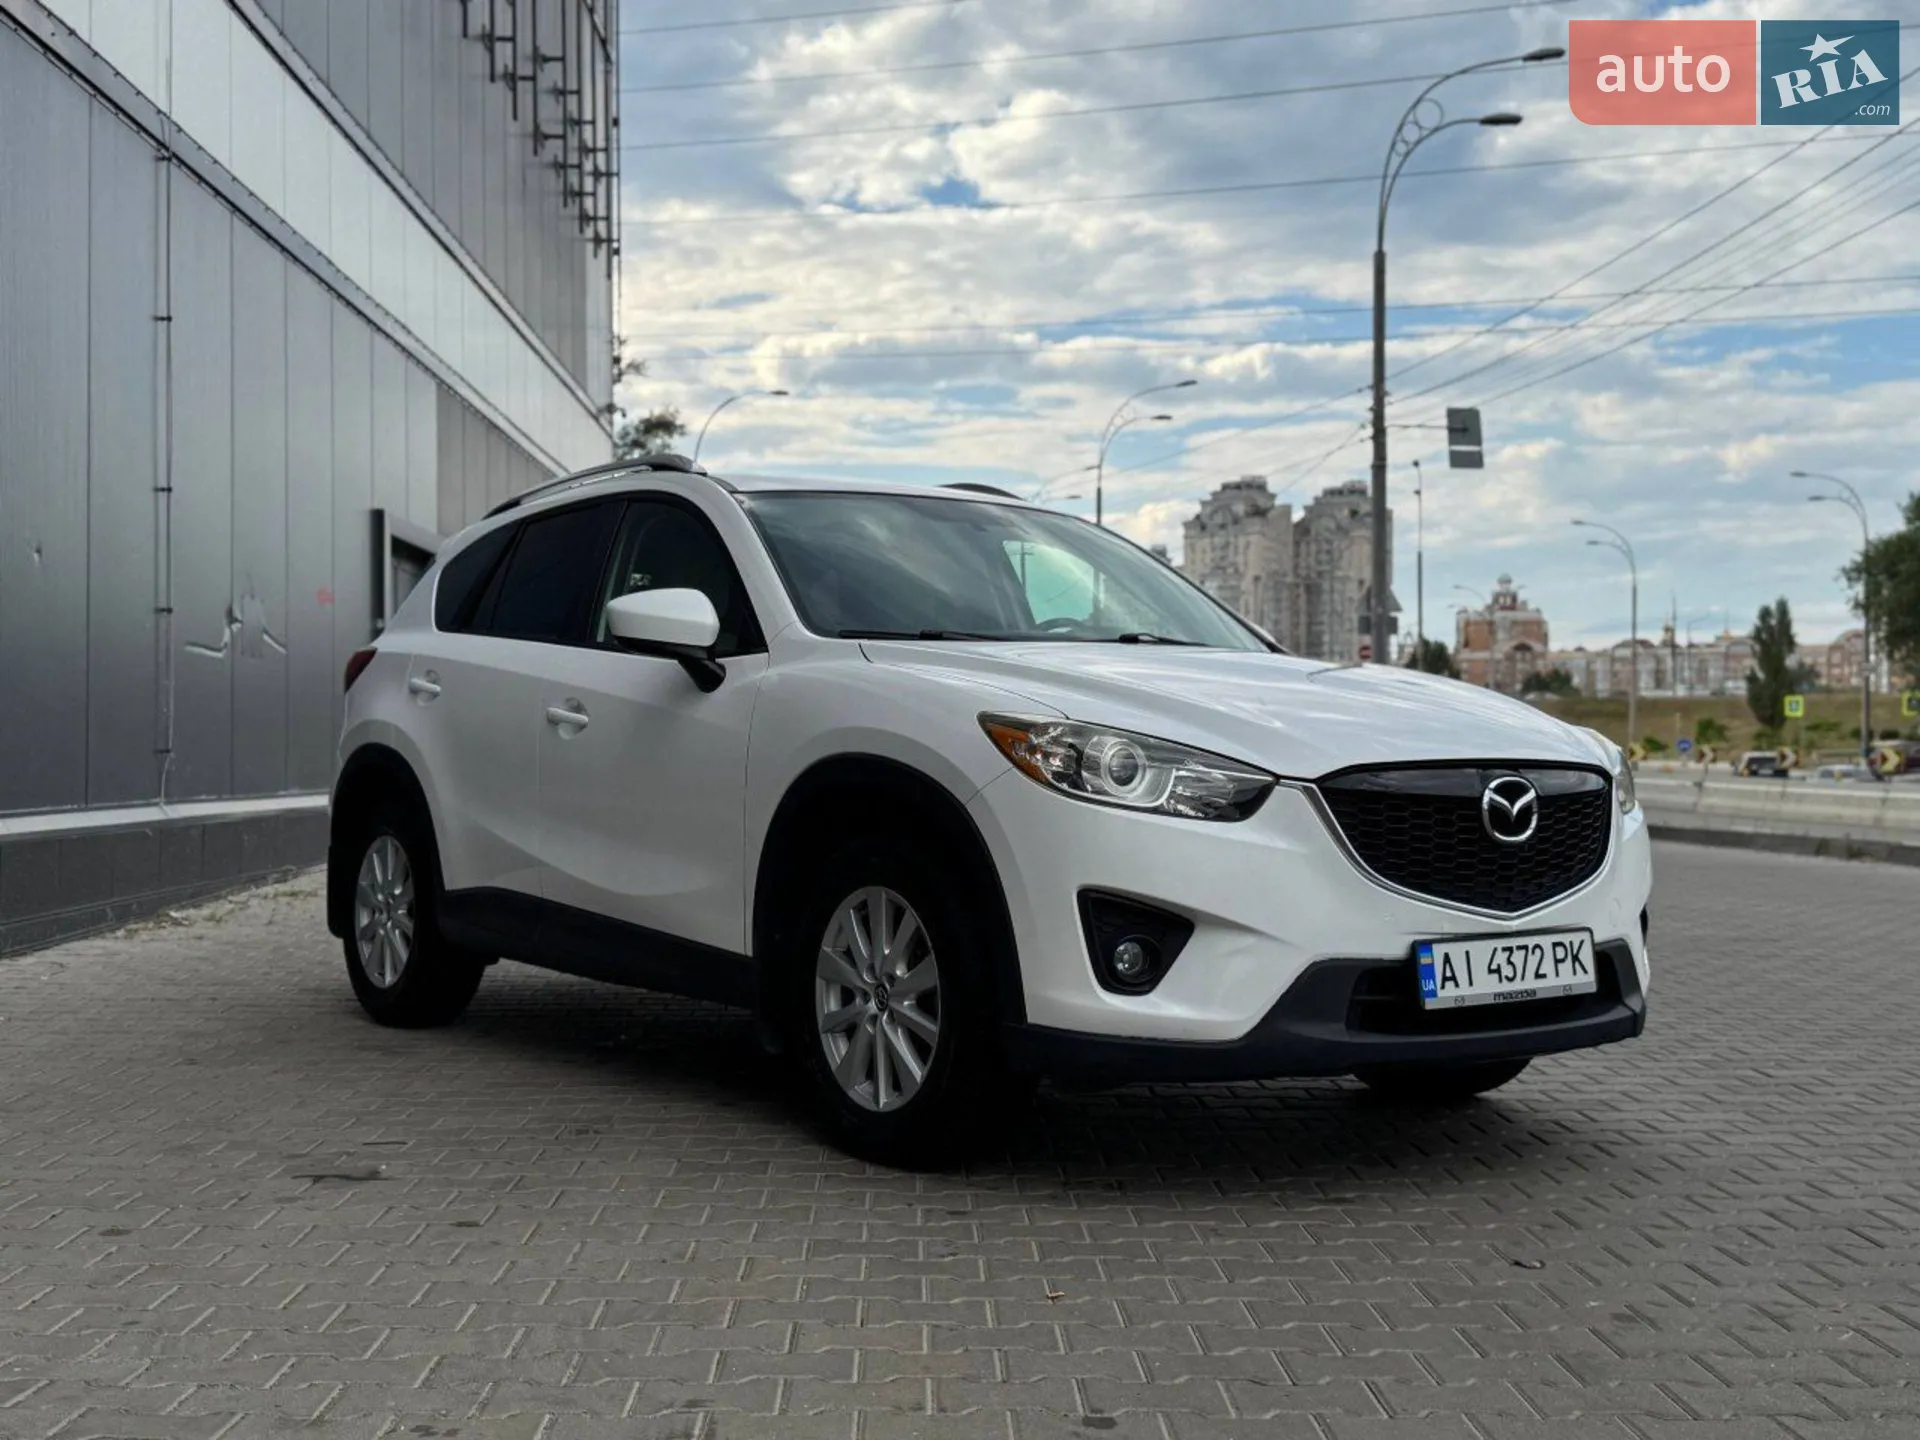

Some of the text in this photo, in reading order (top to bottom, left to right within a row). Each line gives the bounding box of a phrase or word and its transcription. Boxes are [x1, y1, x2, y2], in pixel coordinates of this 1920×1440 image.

[1440, 939, 1588, 990] AI 4372 PK
[1421, 979, 1436, 991] UA
[1493, 988, 1537, 1002] mazda
